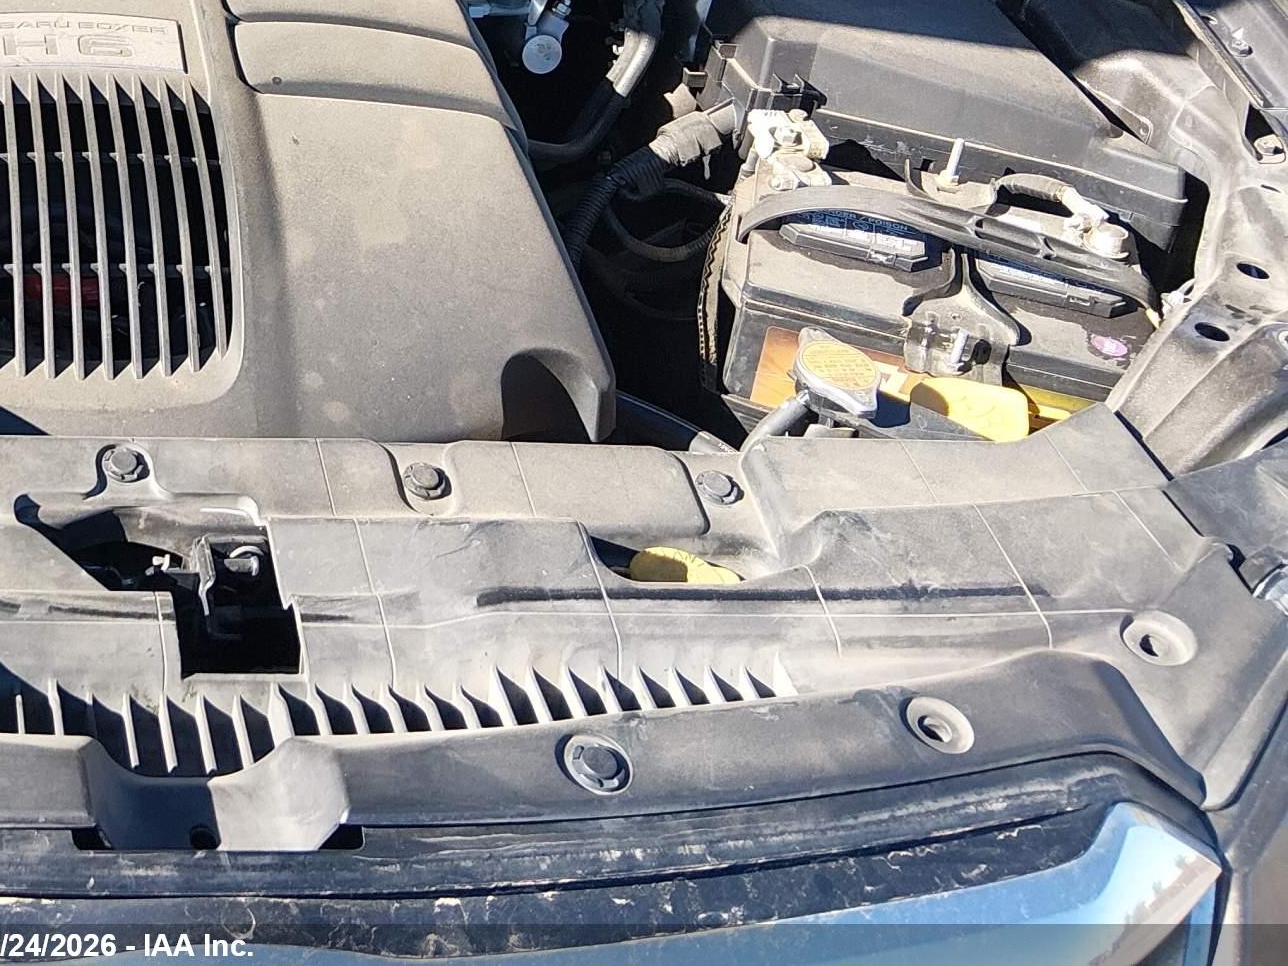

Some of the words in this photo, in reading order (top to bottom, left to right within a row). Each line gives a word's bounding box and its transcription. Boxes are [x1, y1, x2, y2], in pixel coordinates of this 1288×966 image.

[78, 21, 168, 34] BOXER
[2, 34, 133, 58] H6
[868, 217, 908, 231] POISON
